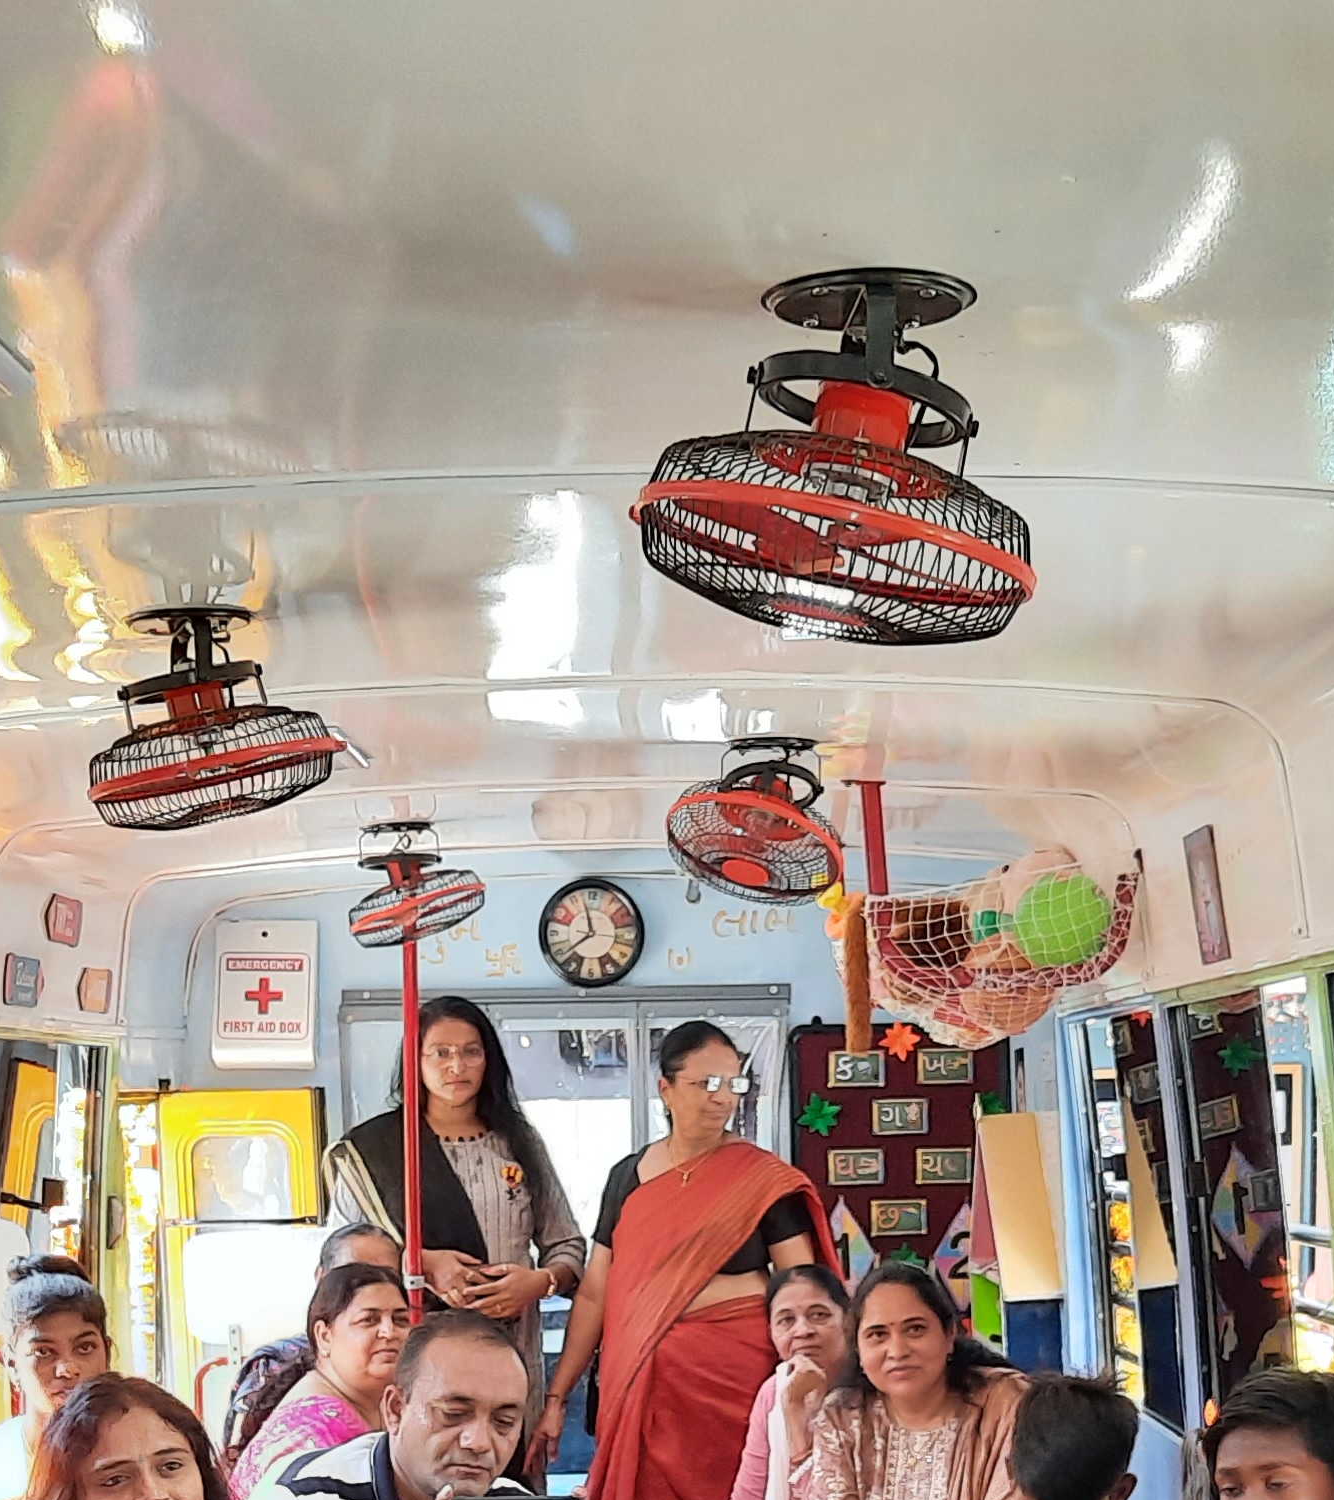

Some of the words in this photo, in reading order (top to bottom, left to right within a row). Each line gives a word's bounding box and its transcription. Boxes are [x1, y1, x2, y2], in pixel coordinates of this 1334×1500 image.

[588, 891, 598, 900] 12
[228, 960, 302, 970] EMERGENCY
[605, 963, 615, 974] 5
[223, 1021, 254, 1032] FIRST
[258, 1021, 276, 1032] AID
[280, 1022, 301, 1033] BOX
[880, 1106, 903, 1128] ગ
[877, 1207, 900, 1230] છ
[834, 1233, 851, 1280] 1
[948, 1231, 970, 1280] 2
